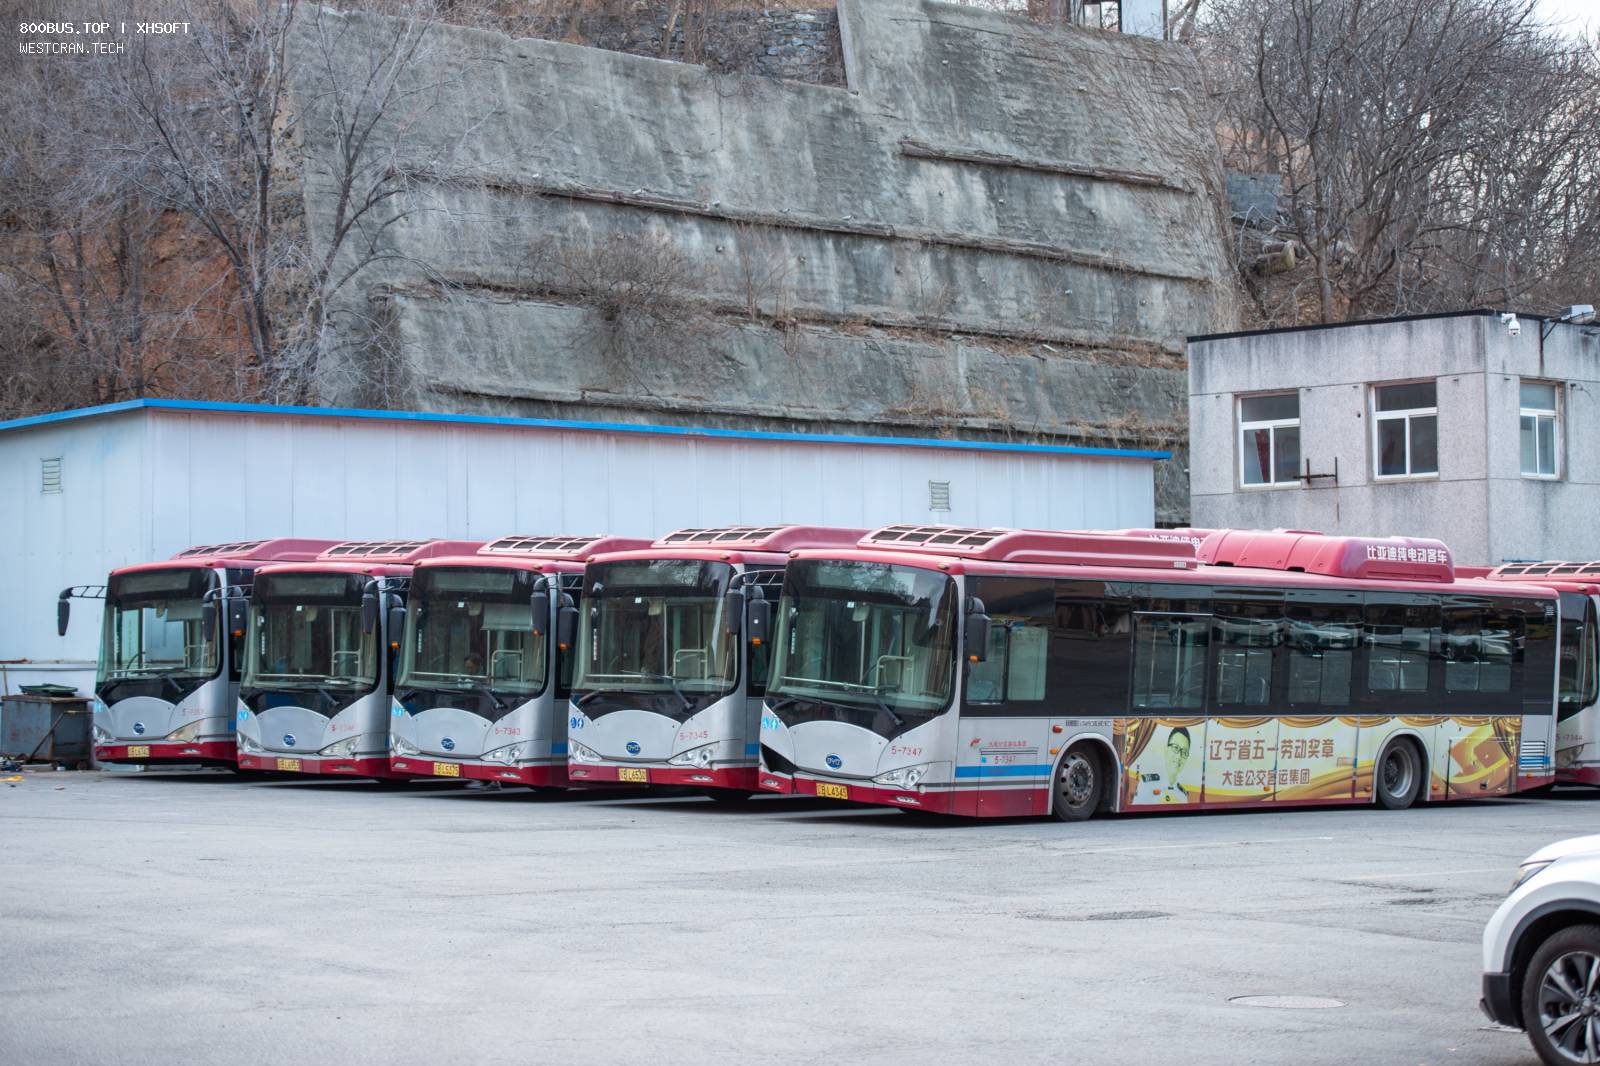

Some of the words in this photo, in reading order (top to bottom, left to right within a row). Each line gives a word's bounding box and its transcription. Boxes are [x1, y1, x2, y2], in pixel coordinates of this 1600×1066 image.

[1366, 545, 1448, 564] 比亚迪纯电动客车
[891, 745, 923, 757] 5-7347
[1209, 739, 1335, 760] 辽宁省五一劳动奖章
[1222, 768, 1310, 786] 大连公交客运集团
